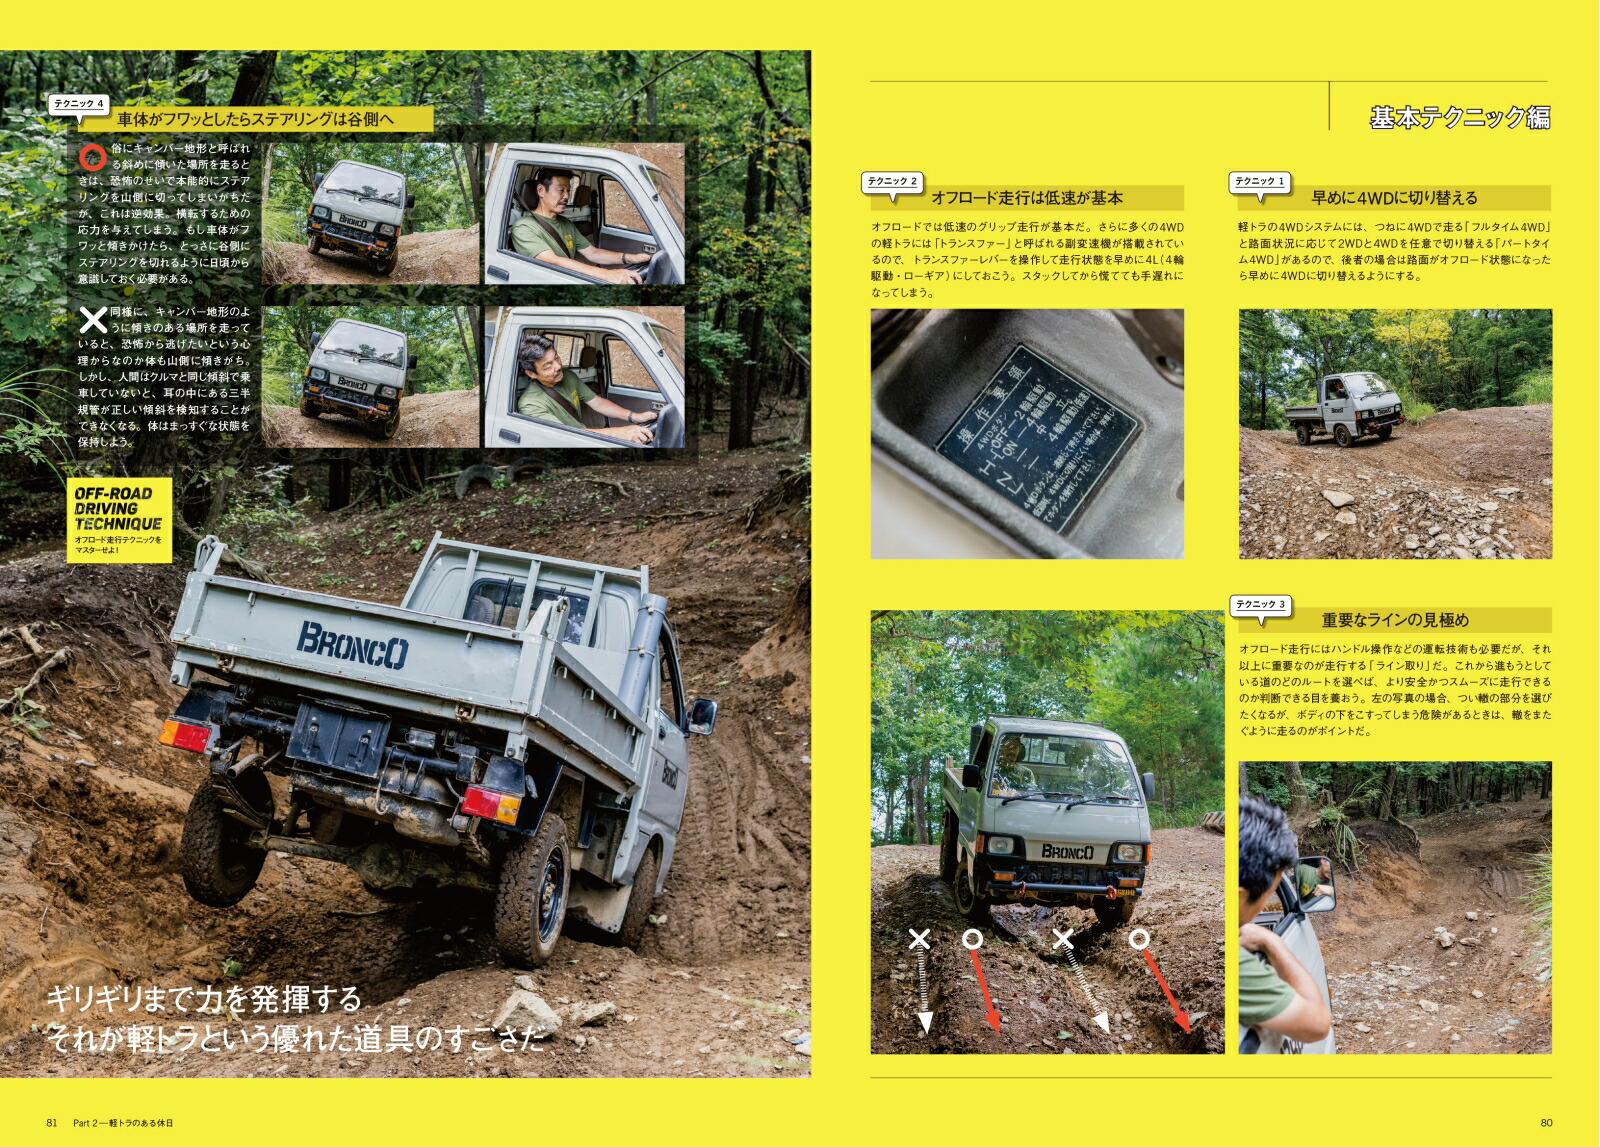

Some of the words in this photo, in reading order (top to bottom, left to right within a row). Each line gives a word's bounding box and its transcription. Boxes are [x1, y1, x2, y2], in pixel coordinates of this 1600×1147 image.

[54, 99, 94, 108] テクニック
[97, 99, 104, 108] 4
[116, 110, 395, 128] 車体がフワッとしたらステアリングは谷側へ
[1370, 105, 1551, 130] 基本テクニック編
[110, 142, 251, 156] 俗にキャンバー地形と呼ばれ
[111, 158, 251, 172] る斜めに傾いた場所を走ると
[77, 174, 251, 188] きは、恐怖のせいで本能的にステア
[867, 176, 908, 186] テクニック
[911, 176, 917, 186] 2
[1235, 176, 1275, 186] テクニック
[1279, 176, 1284, 186] 1
[77, 190, 251, 204] リングを山側に切ってしまいがちだ
[931, 189, 1124, 206] オフロード走行は低速が基本
[1311, 189, 1478, 207] 早めに4WDに切り替える
[77, 207, 251, 221] が、これは逆効果。横転するための
[339, 213, 368, 228] BRONCO
[77, 223, 251, 237] 応力を与えてしまう。もし車体がフ
[872, 220, 1185, 233] オフロードでは低速のグリップ走行が基本だ。さらに多くの4WD
[1237, 220, 1550, 233] 軽トラの4WDシステムには、つねに4WDで走る「フルタイム4WD」
[77, 239, 251, 253] ワッと傾きかけたら、とっさに谷側に
[871, 237, 1184, 250] の軽トラには「トランスファー」と呼ばれる副変速機が搭載されてい
[1239, 237, 1550, 250] と路面状況に応じて2WDと4WDを任意で切り替える「パートタイ
[77, 255, 251, 269] ステアリングを切れるように日頃から
[1238, 254, 1551, 266] ム4WD」があるので、後者の場合は路面がオフロード状態になった
[77, 272, 195, 286] 意識しておく必要がある。
[1239, 270, 1421, 282] ら早めに4WDに切り替えるようにする。
[871, 287, 933, 299] なってしまう。
[109, 305, 251, 318] 同様に、キャンバー地形のよ
[111, 321, 251, 334] うに傾きのある場所を走って
[77, 337, 251, 350] いると、恐怖から逃げたいという心
[77, 354, 251, 367] 理からなのか体も山側に傾きがち。
[77, 370, 251, 384] しかし、人間はクルマと同じ傾斜で乗
[337, 376, 368, 391] BRONCO
[77, 386, 251, 400] 車していないと、耳の中にある三半
[1013, 381, 1046, 420] 2輪駆動
[77, 403, 251, 416] 規管が正しい傾斜を検知することが
[1024, 389, 1057, 428] 4輪駆動
[77, 419, 251, 433] できなくなる。体はまっすぐな状態を
[77, 435, 134, 449] 保持しよう。
[990, 426, 1011, 449] OFF
[1001, 439, 1018, 457] ON
[979, 458, 995, 476] H
[996, 470, 1012, 487] N
[74, 487, 153, 500] OFF-ROAD
[74, 502, 139, 515] DRIVING
[75, 517, 163, 532] TECHNIQUE
[75, 535, 162, 545] オフロード走行テクニックを
[1236, 599, 1276, 609] テクニック
[1279, 600, 1285, 609] 3
[1321, 611, 1470, 629] 重要なラインの見極め
[296, 620, 409, 671] BRONCO
[1239, 643, 1552, 655] オフロード走行にはハンドル操作などの運転技術も必要だが、それ
[1238, 659, 1552, 672] 以上に重要なのが走行する「ライン取り」だ。これから進もうとして
[1239, 676, 1551, 688] いる道のどのルートを選べば、より安全かつスムーズに走行できる
[1239, 692, 1553, 704] のか判断できる目を養おう。左の写真の場合、つい轍の部分を選び
[1239, 709, 1552, 721] たくなるが、ボディの下をこすってしまう危険があるときは、轍をまた
[1240, 725, 1371, 737] ぐように走るのがポイントだ。
[1041, 843, 1095, 861] BRONCO
[47, 984, 362, 1013] ギリギリまで力を発揮する
[47, 1024, 546, 1055] それが軽トラという優れた道具のすごさだ
[46, 1118, 57, 1128] 81
[73, 1118, 90, 1128] Part
[1540, 1118, 1554, 1128] 80
